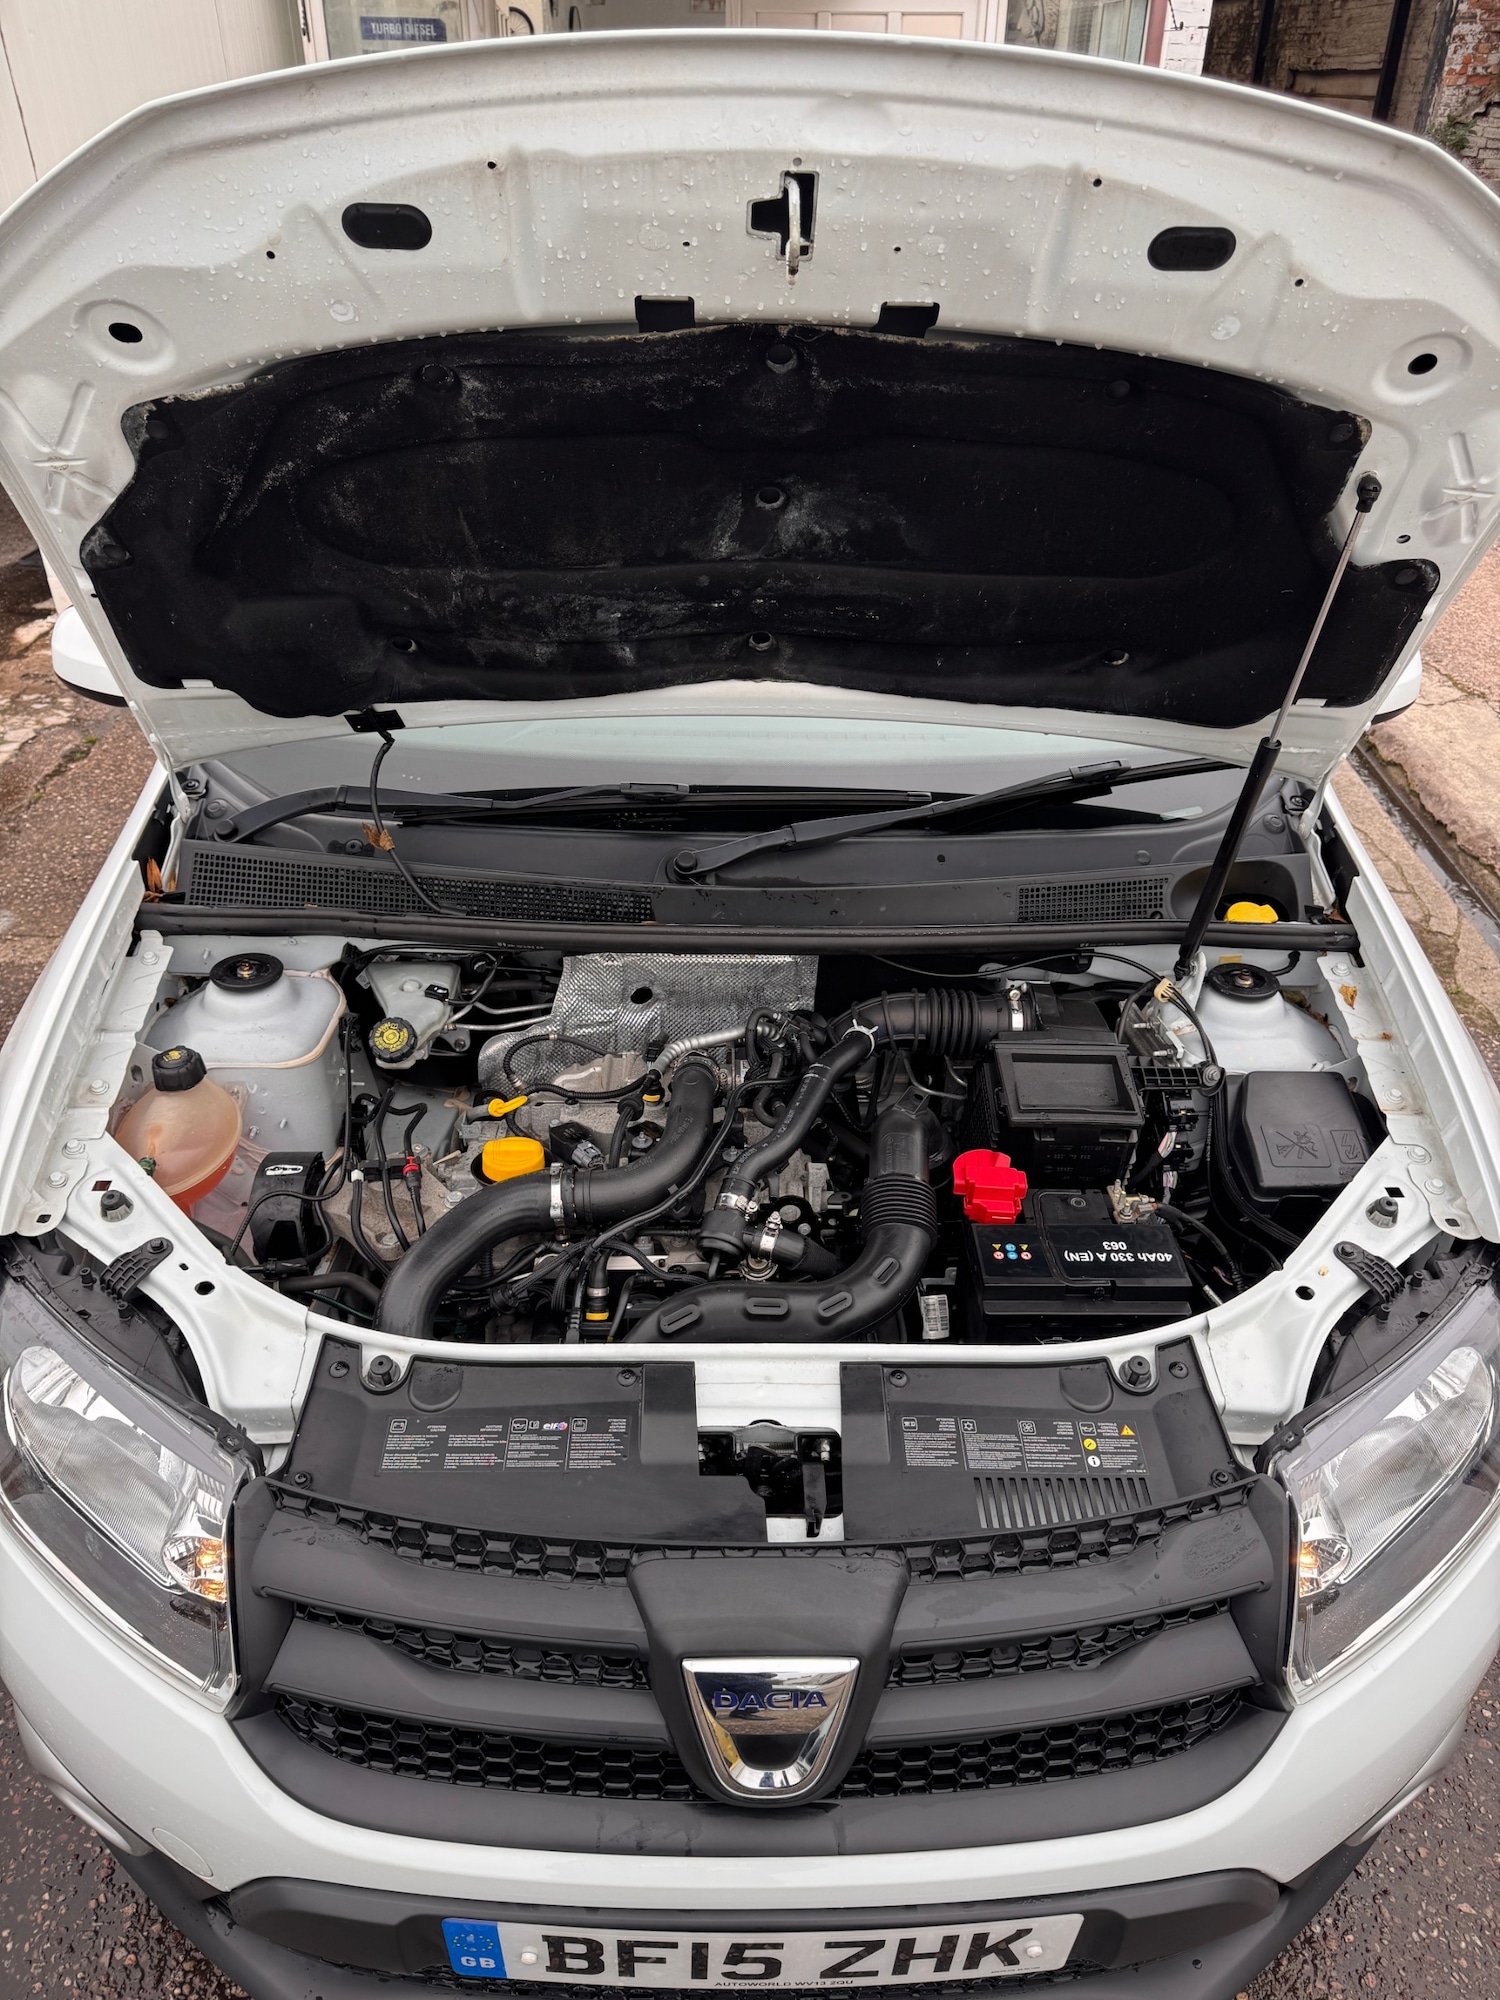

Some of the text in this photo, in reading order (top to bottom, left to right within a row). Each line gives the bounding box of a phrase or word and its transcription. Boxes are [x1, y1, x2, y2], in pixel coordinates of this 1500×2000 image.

[370, 22, 437, 36] TURBO DIESEL
[1102, 1241, 1128, 1251] 063
[1063, 1250, 1174, 1262] 40Ah 330 A (EN)
[713, 1690, 828, 1711] DACIA
[541, 1928, 1033, 1981] BF15 ZHK
[460, 1956, 497, 1969] GB
